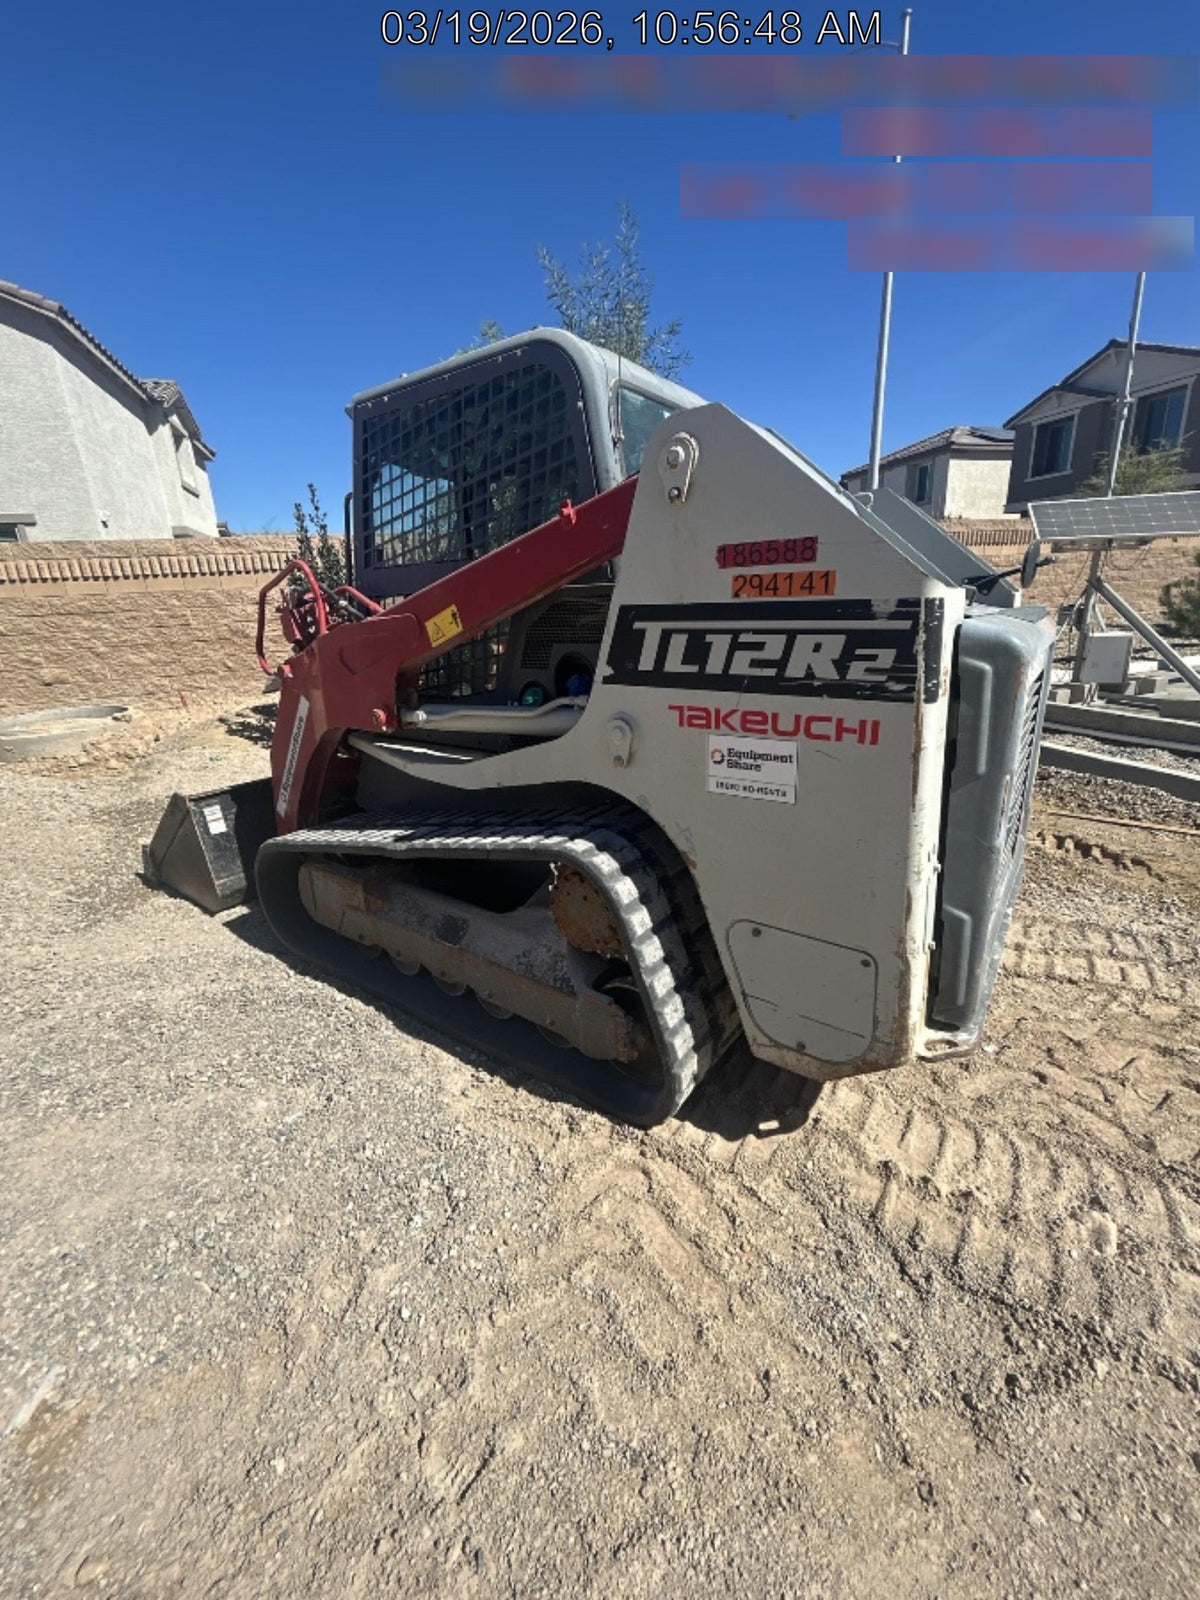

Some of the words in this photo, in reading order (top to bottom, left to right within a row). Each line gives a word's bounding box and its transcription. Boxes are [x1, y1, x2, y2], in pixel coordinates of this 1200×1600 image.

[719, 537, 817, 568] 186588
[732, 570, 830, 598] 294141
[726, 747, 794, 764] Equipment
[726, 758, 762, 772] Share
